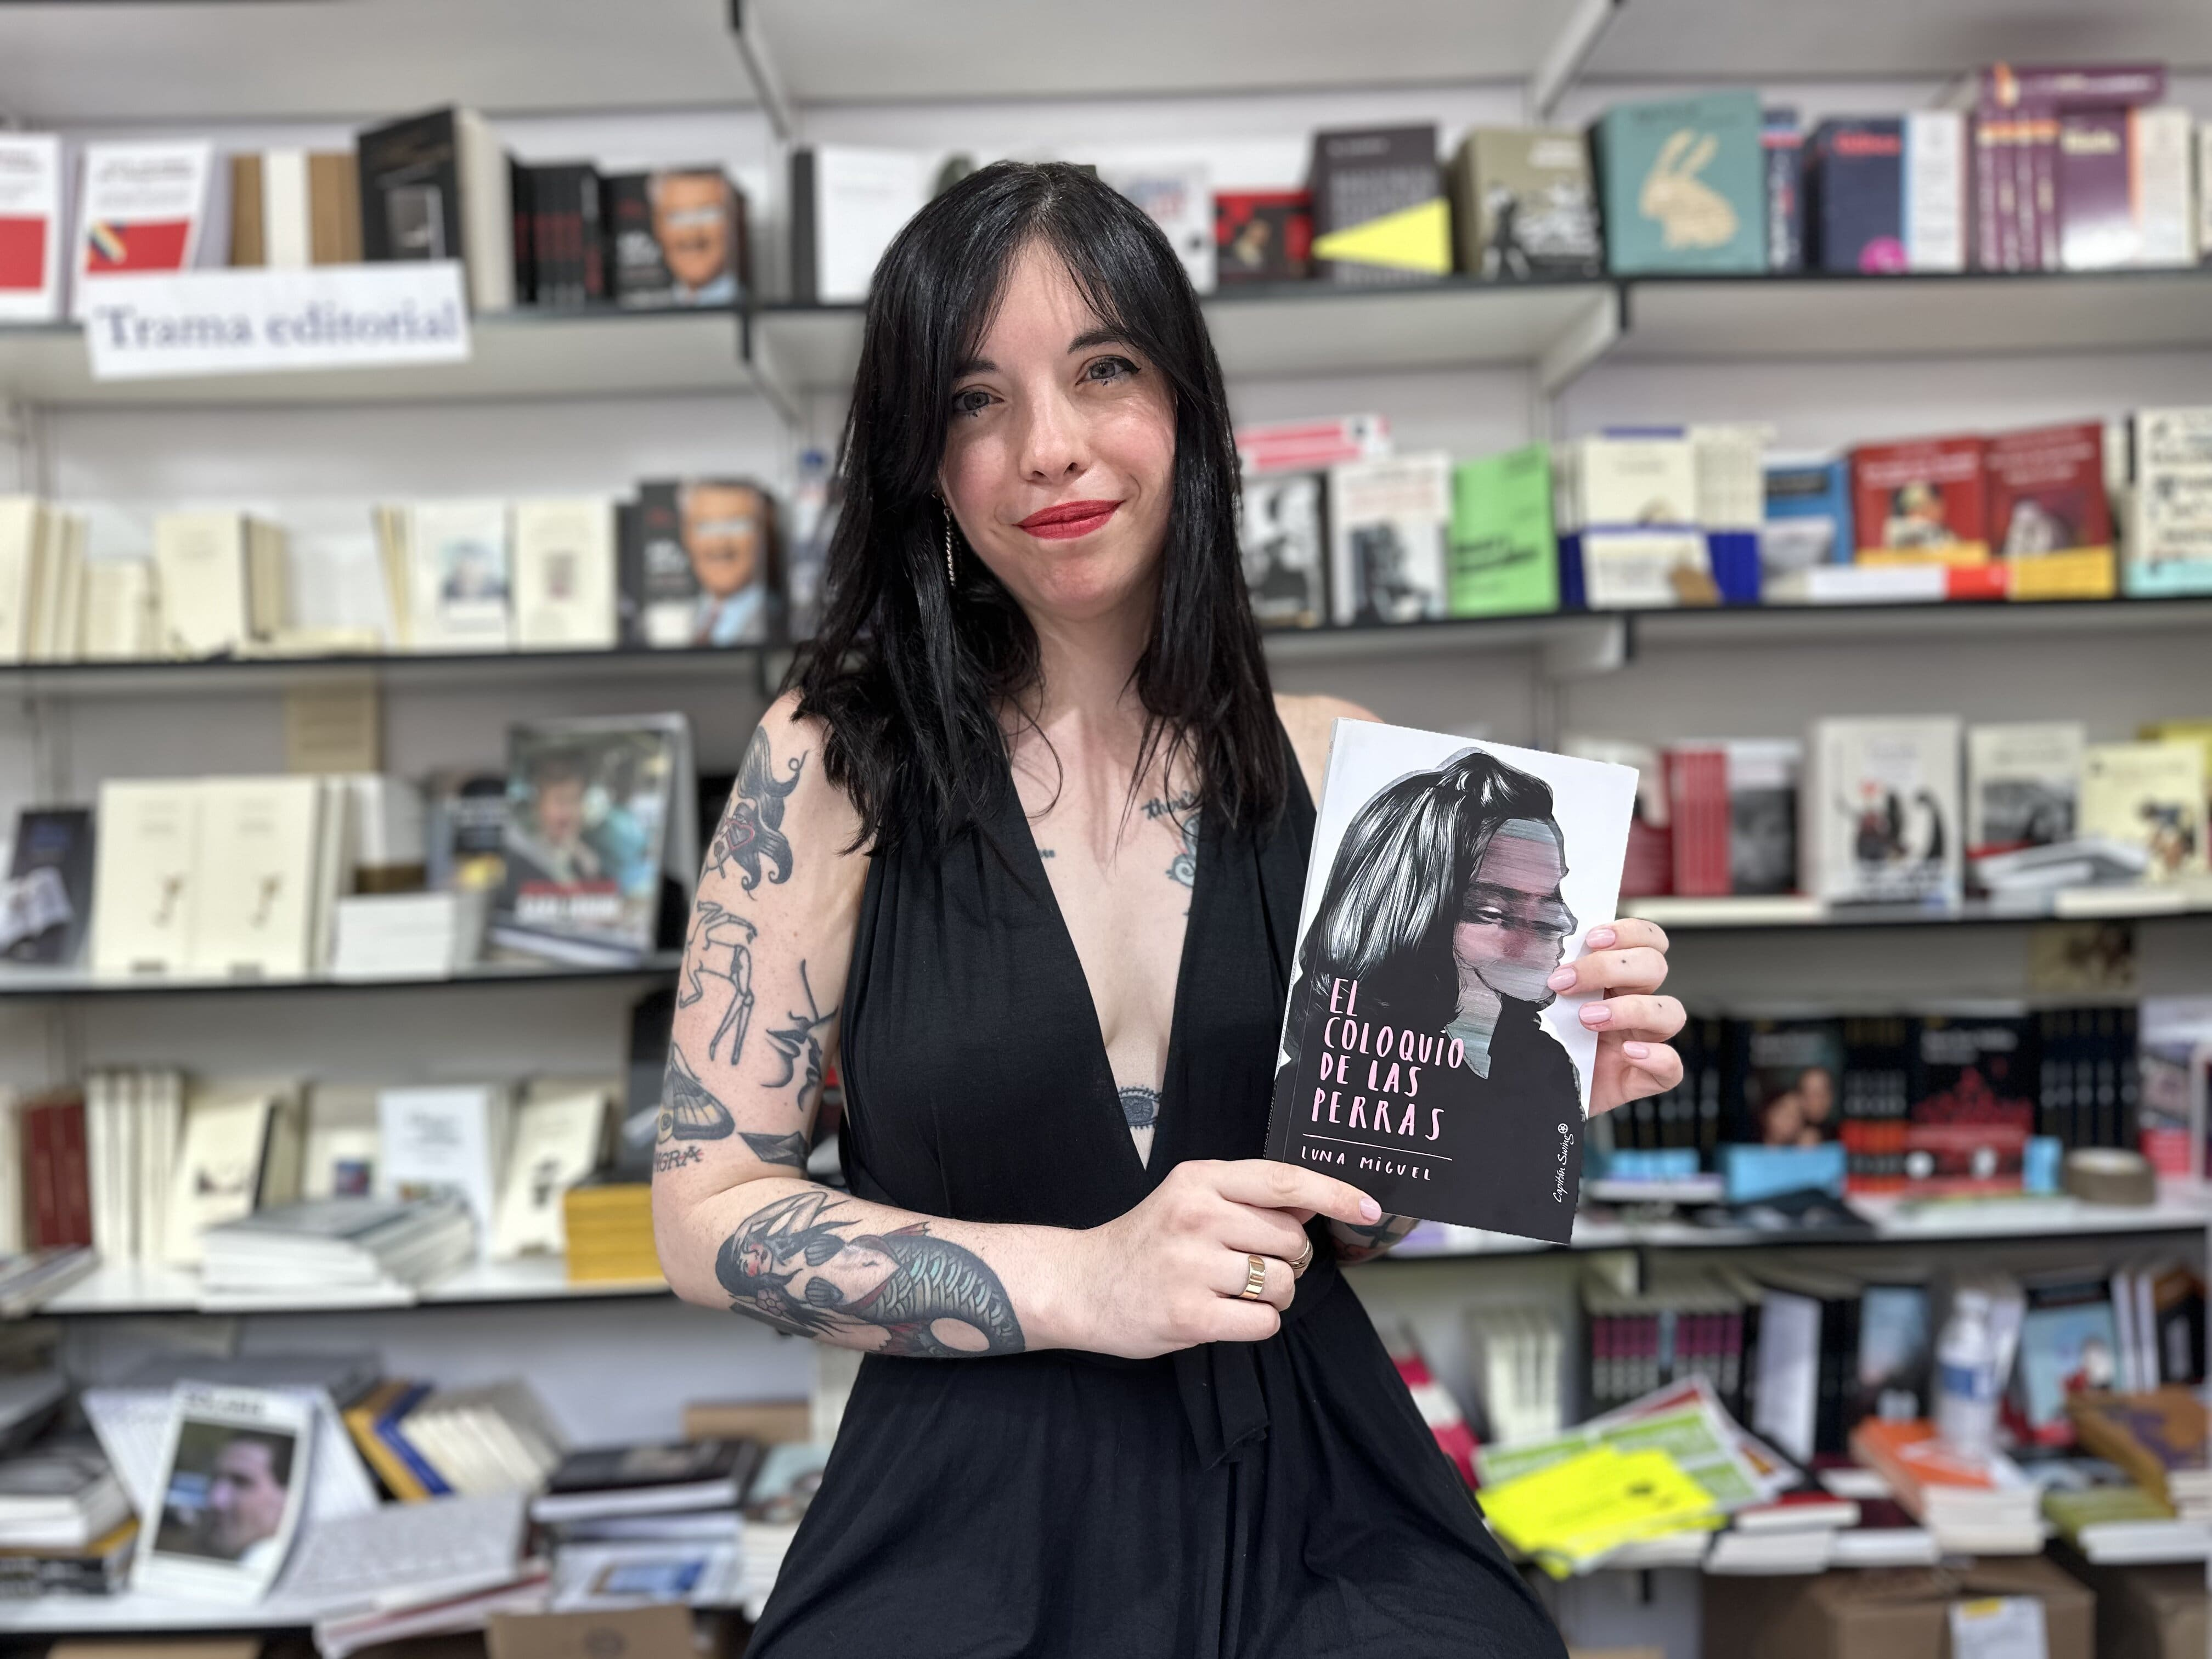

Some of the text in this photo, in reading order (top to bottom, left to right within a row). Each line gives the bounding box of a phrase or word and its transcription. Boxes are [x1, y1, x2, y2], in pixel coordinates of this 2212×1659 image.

[94, 298, 460, 349] Trama editorial
[1330, 978, 1358, 1017] EL
[1324, 1017, 1464, 1068] COLOQUIO
[1320, 1052, 1421, 1097] DE LAS
[1311, 1087, 1444, 1141] PERRAS
[1301, 1146, 1431, 1181] LUNA MIGUEL
[1553, 1133, 1574, 1203] Capitán Swing
